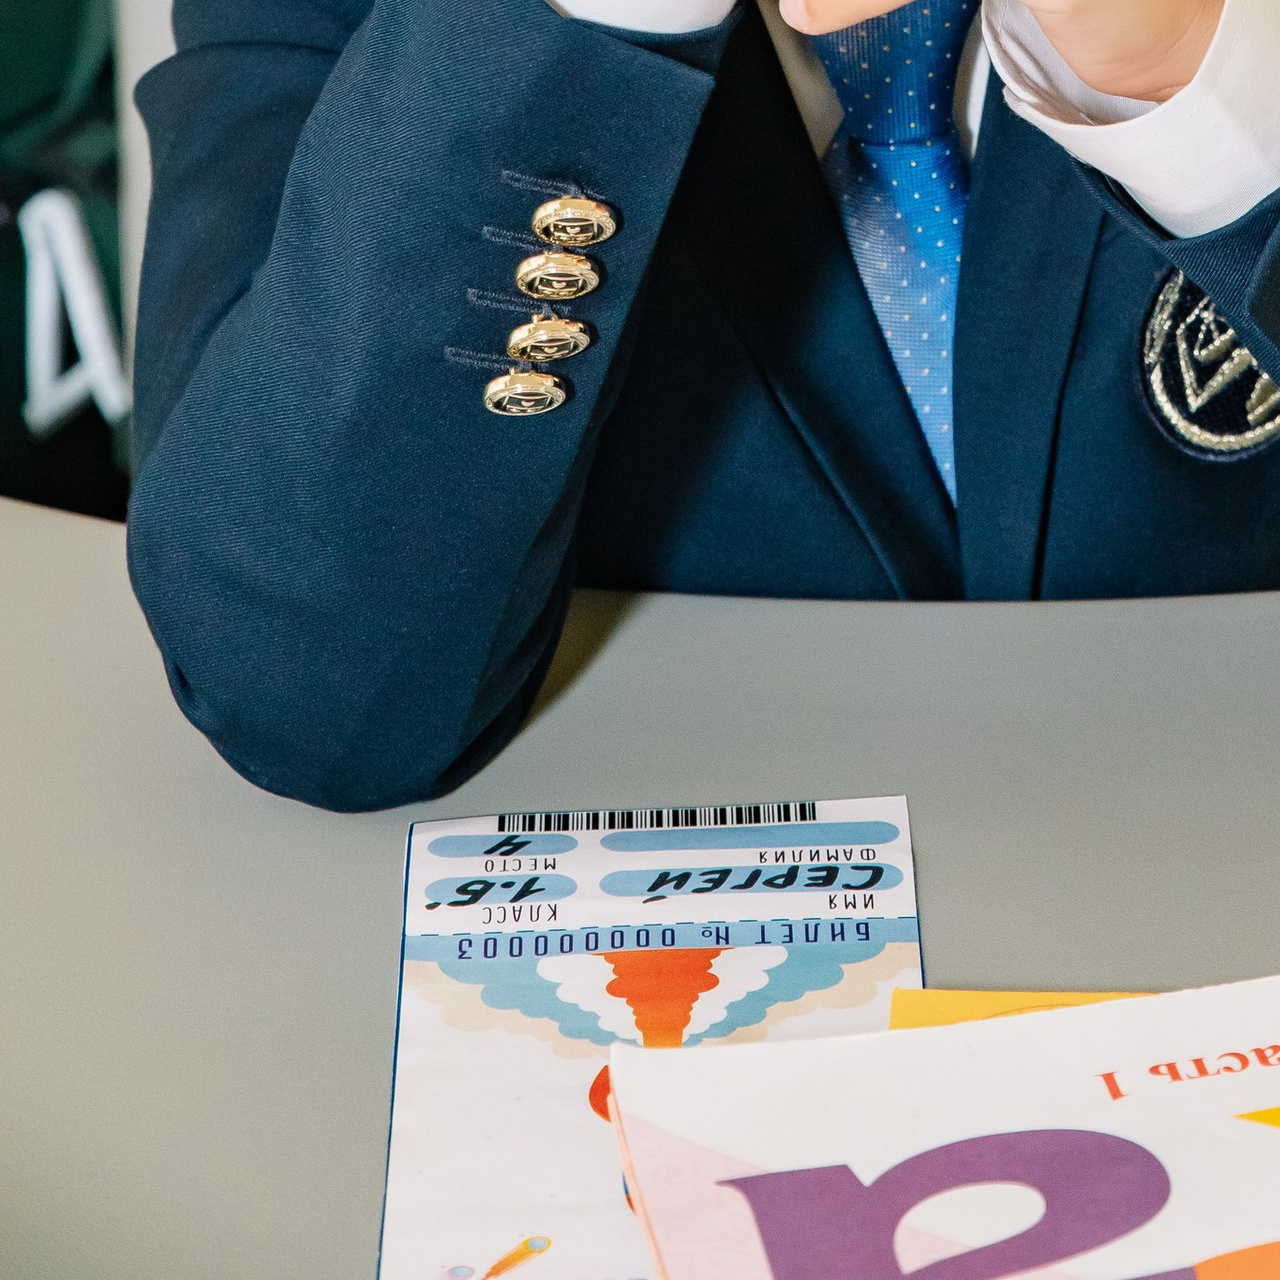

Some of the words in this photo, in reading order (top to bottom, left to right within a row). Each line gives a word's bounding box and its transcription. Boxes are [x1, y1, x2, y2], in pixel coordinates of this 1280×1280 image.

[483, 857, 557, 873] МЕСТО
[758, 848, 877, 864] ФАМИЛИЯ
[642, 864, 885, 905] СЕРГЕЙ
[828, 893, 875, 911] ИМЯ
[481, 903, 558, 925] КЛАСС
[457, 927, 676, 960] 000000003
[701, 925, 730, 945] №
[754, 921, 871, 945] БИЛЕТ
